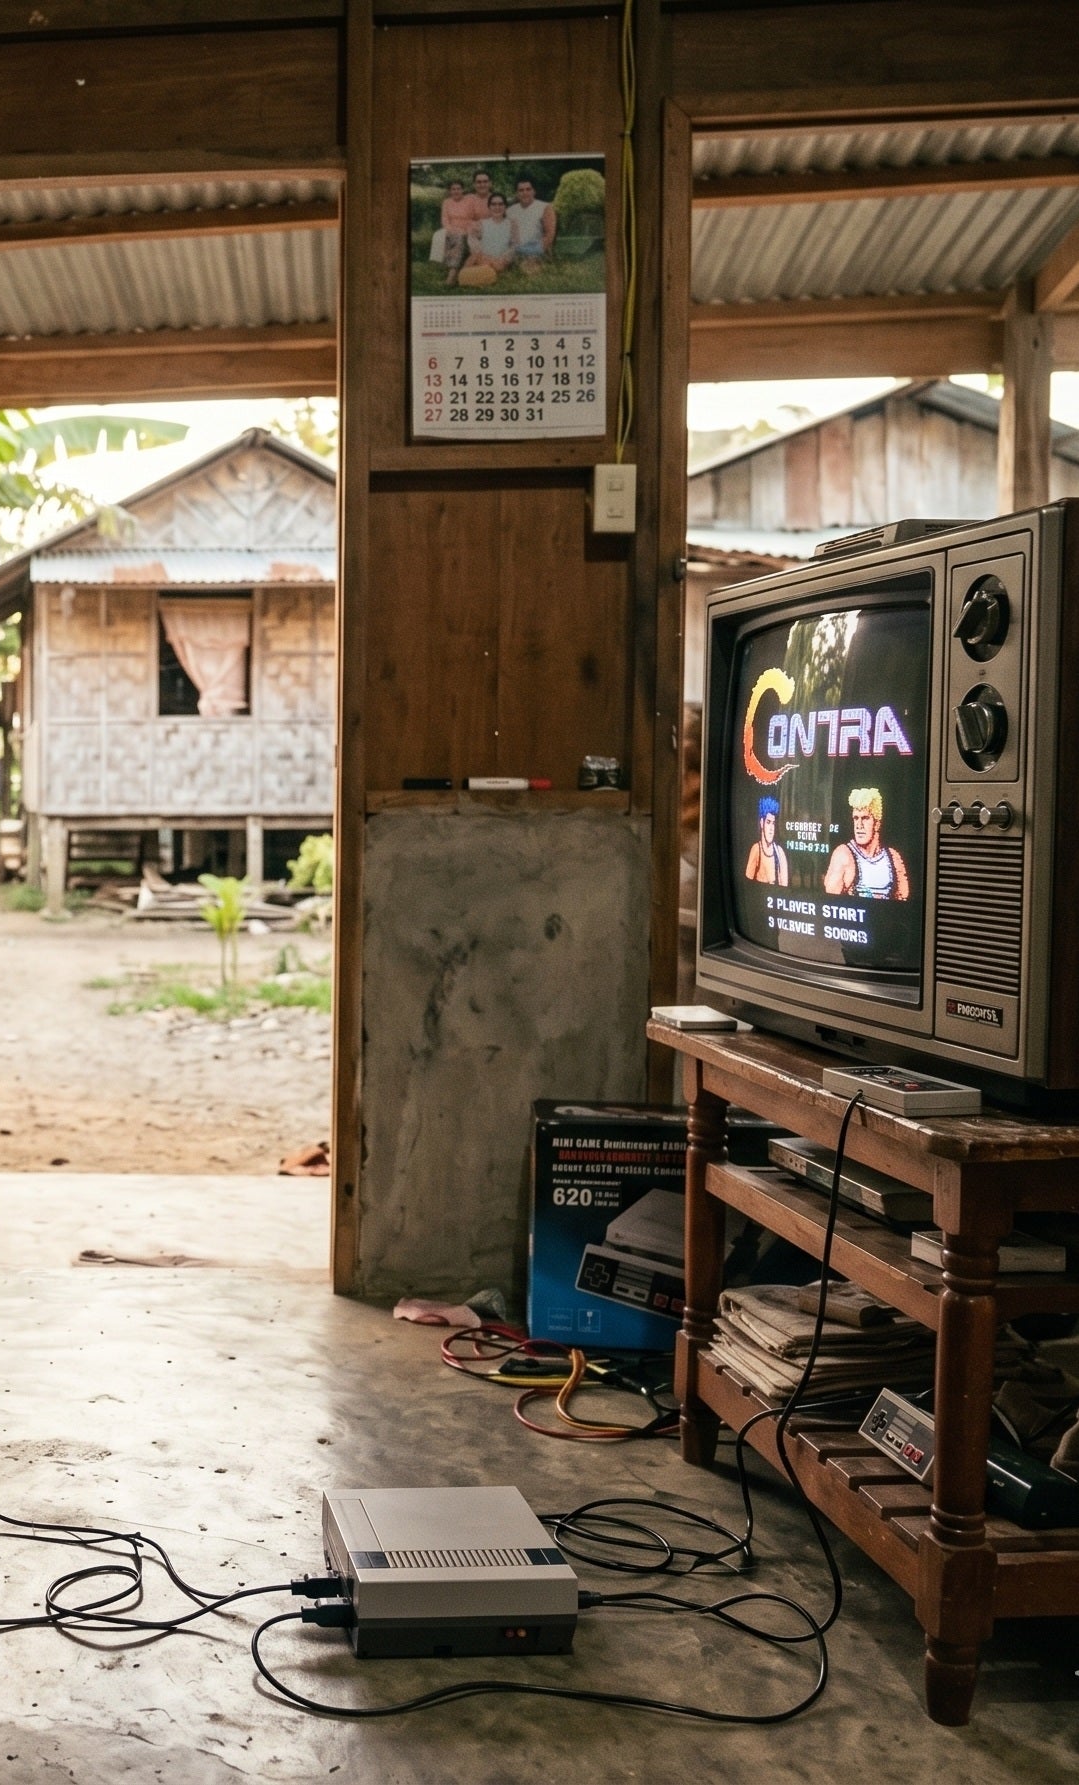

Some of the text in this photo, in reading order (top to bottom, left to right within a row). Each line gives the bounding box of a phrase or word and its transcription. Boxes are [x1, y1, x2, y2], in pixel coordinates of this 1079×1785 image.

[497, 308, 520, 324] 12
[481, 337, 592, 351] 1 2 3 4 5
[428, 354, 595, 370] 6 7 8 9 10 11 12
[424, 372, 595, 387] 13 14 15 16 17 18 19
[424, 389, 595, 404] 20 21 22 23 24 25 26
[425, 408, 543, 422] 27 28 29 30 31
[743, 667, 914, 786] CONTRA
[766, 896, 775, 909] 2
[822, 904, 866, 923] START
[575, 1138, 601, 1149] GAME
[552, 1187, 593, 1207] 620
